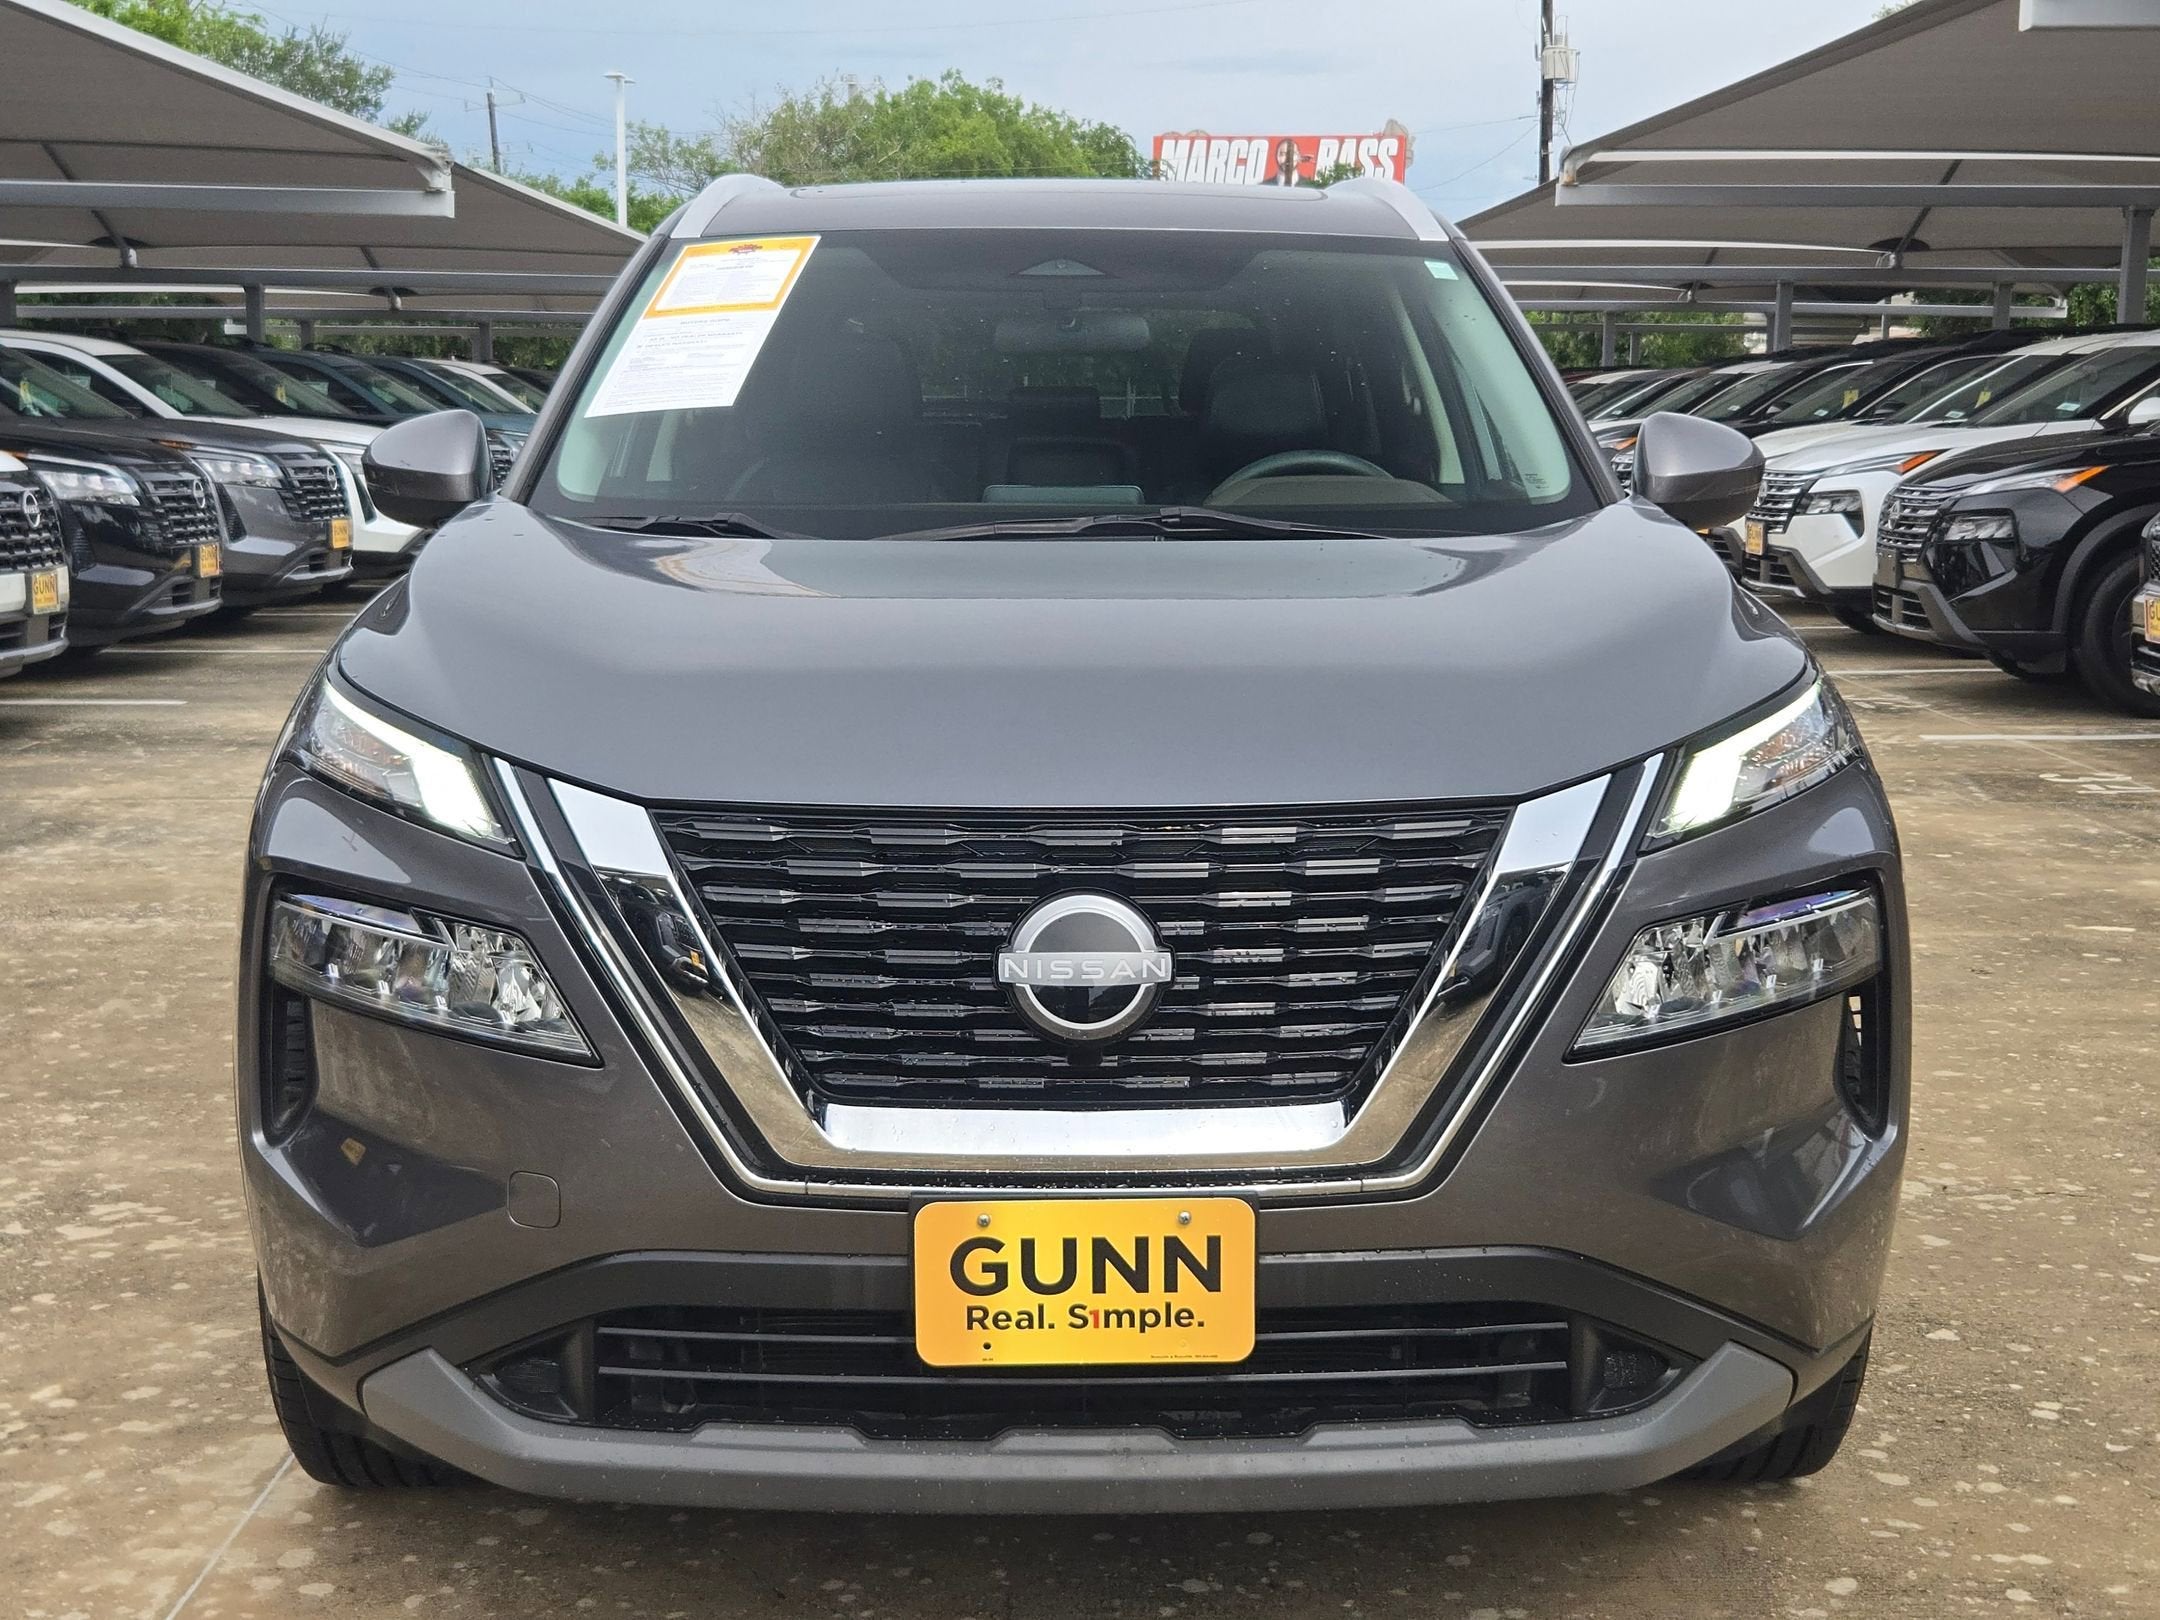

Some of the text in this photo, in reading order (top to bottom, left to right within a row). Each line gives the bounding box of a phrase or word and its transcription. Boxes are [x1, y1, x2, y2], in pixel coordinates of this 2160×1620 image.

[1160, 139, 1269, 184] MARCO
[33, 575, 56, 595] GUNN
[1004, 958, 1166, 979] NISSAN
[950, 1235, 1222, 1296] GUNN
[966, 1303, 1055, 1330] Real.
